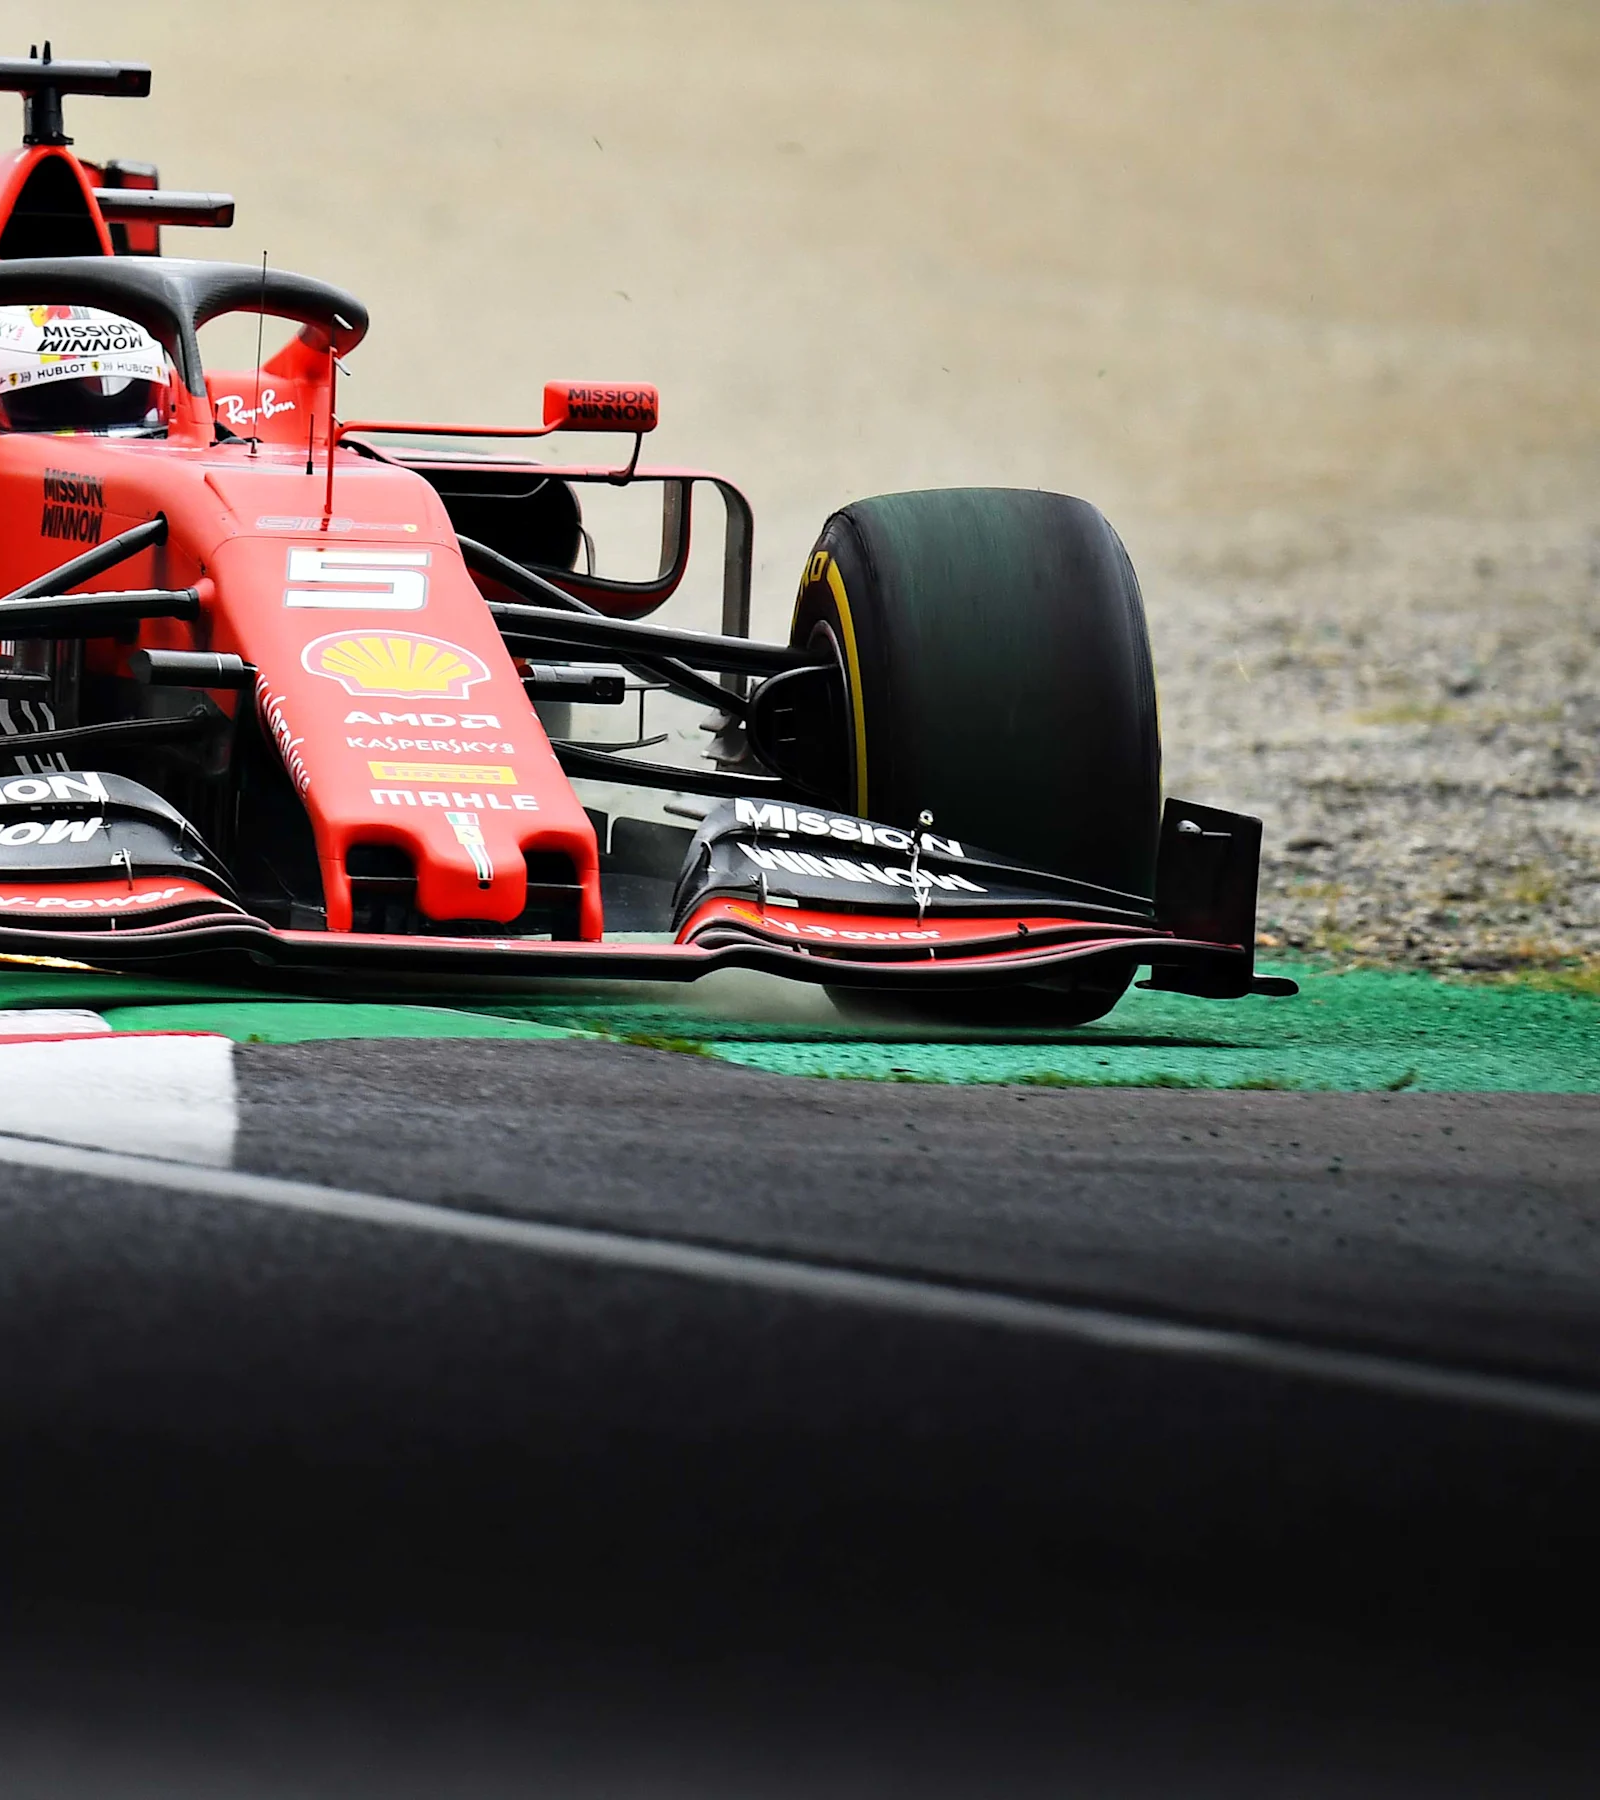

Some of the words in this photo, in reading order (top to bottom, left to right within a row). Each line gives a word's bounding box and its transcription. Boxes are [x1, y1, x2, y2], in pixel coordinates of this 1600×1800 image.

[43, 321, 138, 338] MISSION
[37, 335, 143, 352] WINNOW
[37, 363, 86, 379] HUBLOT
[214, 389, 296, 425] Ray-Ban
[567, 389, 655, 404] MISSION
[567, 403, 657, 421] WINNOW
[44, 468, 104, 508] MISSION
[41, 503, 103, 545] WINNOW
[283, 547, 432, 612] 5
[343, 711, 456, 727] AMD
[346, 736, 500, 754] KASPERSKY
[370, 789, 540, 811] MAHLE
[734, 798, 966, 858] MISSION
[735, 841, 989, 893] WINNOW
[765, 917, 941, 940] V-Power
